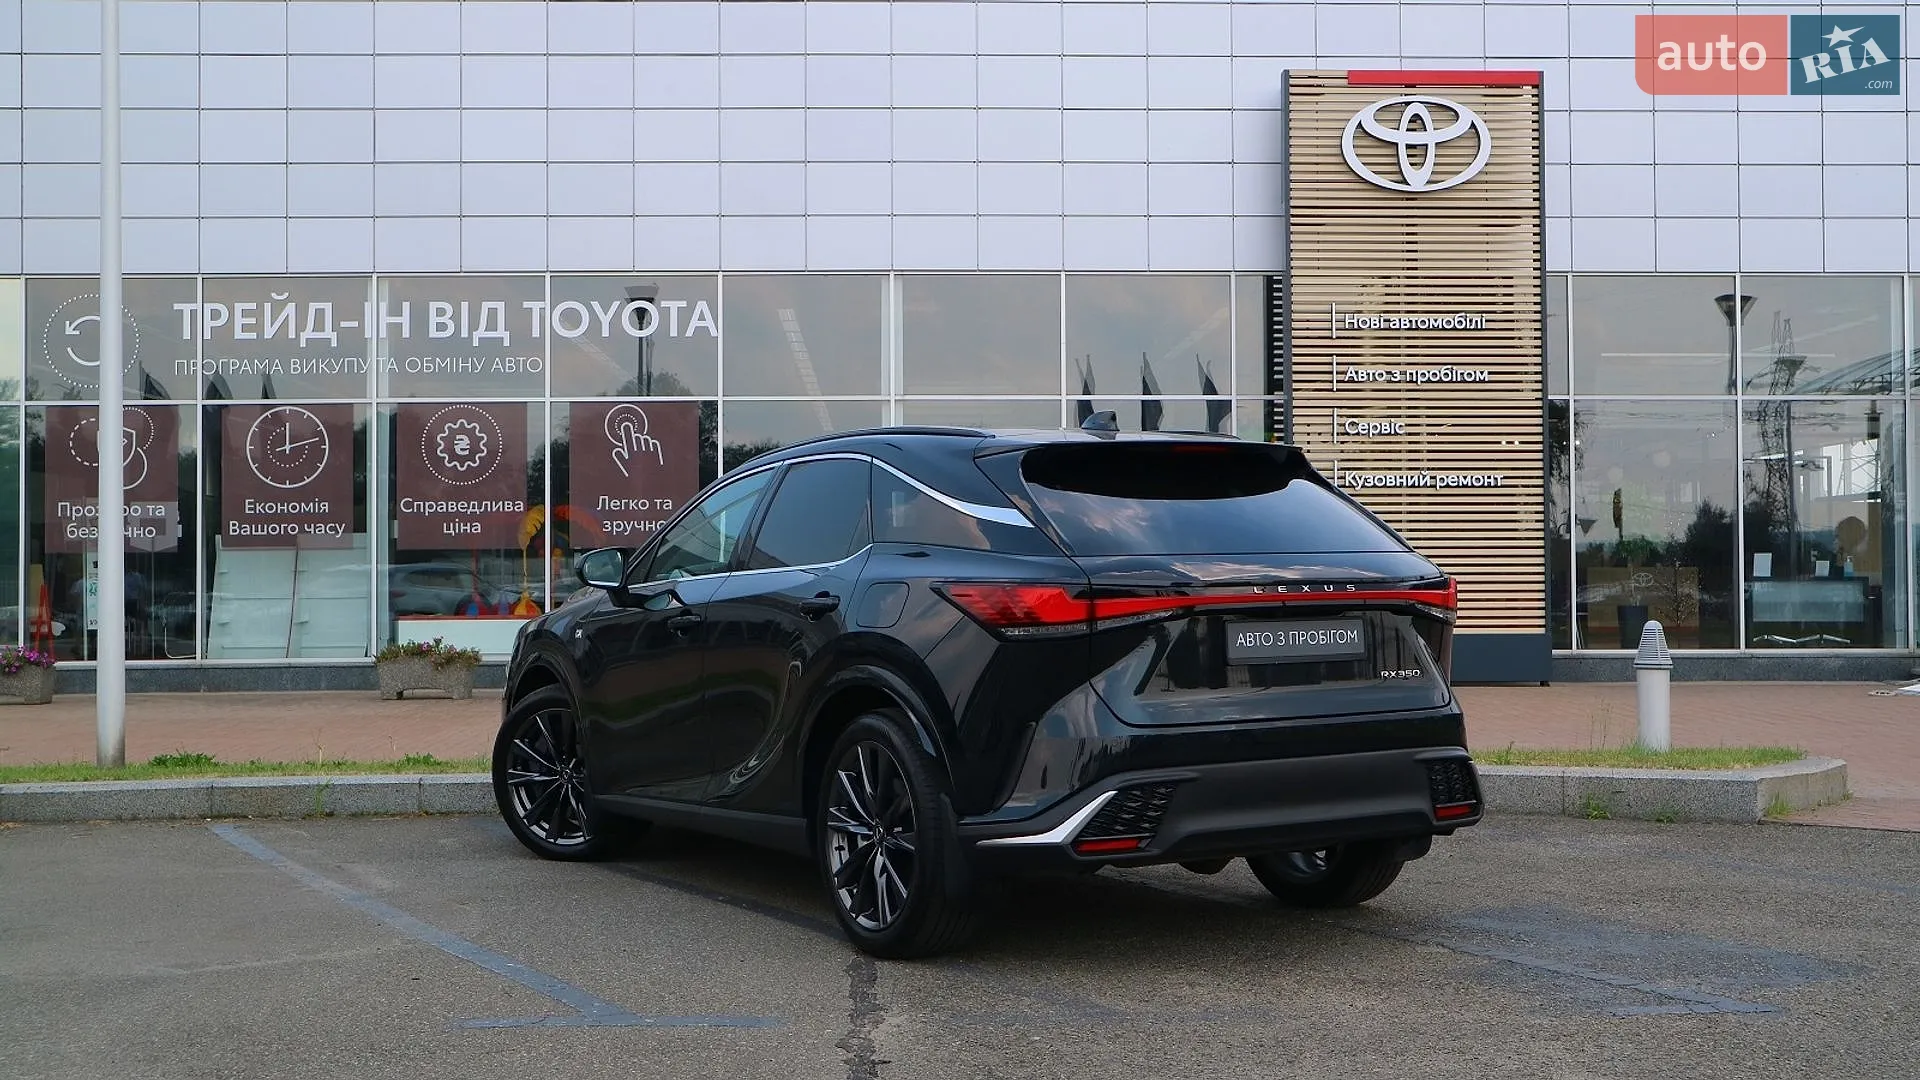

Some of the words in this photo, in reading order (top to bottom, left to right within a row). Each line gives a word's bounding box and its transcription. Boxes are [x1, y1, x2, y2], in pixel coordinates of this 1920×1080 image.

[173, 291, 411, 347] ТРЕЙД-ІН
[429, 301, 510, 347] ВІД
[523, 300, 718, 338] TOYOTA
[1345, 313, 1384, 329] Нові
[1389, 312, 1486, 329] автомобілі
[175, 358, 284, 375] ПРОГРАМА
[290, 357, 371, 375] ВИКУПУ
[376, 357, 399, 373] ТА
[405, 356, 486, 374] ОБМІНУ
[491, 357, 543, 373] АВТО
[1345, 366, 1387, 382] Авто
[1391, 369, 1401, 382] з
[1406, 365, 1488, 385] пробігом
[1345, 418, 1405, 438] Сервіс
[1345, 469, 1431, 491] Кузовний
[1436, 473, 1503, 490] ремонт
[146, 505, 165, 516] та
[244, 498, 329, 514] Економія
[400, 498, 524, 516] Справедлива
[596, 495, 649, 510] Легко
[654, 499, 672, 510] та
[66, 523, 156, 538] безчно
[229, 520, 299, 535] Вашого
[304, 523, 346, 538] часу
[443, 519, 481, 536] ціна
[1254, 584, 1356, 594] LEXUS
[1235, 631, 1274, 648] АВТО
[1277, 631, 1286, 646] З
[1289, 628, 1359, 646] ПРОБІГОМ
